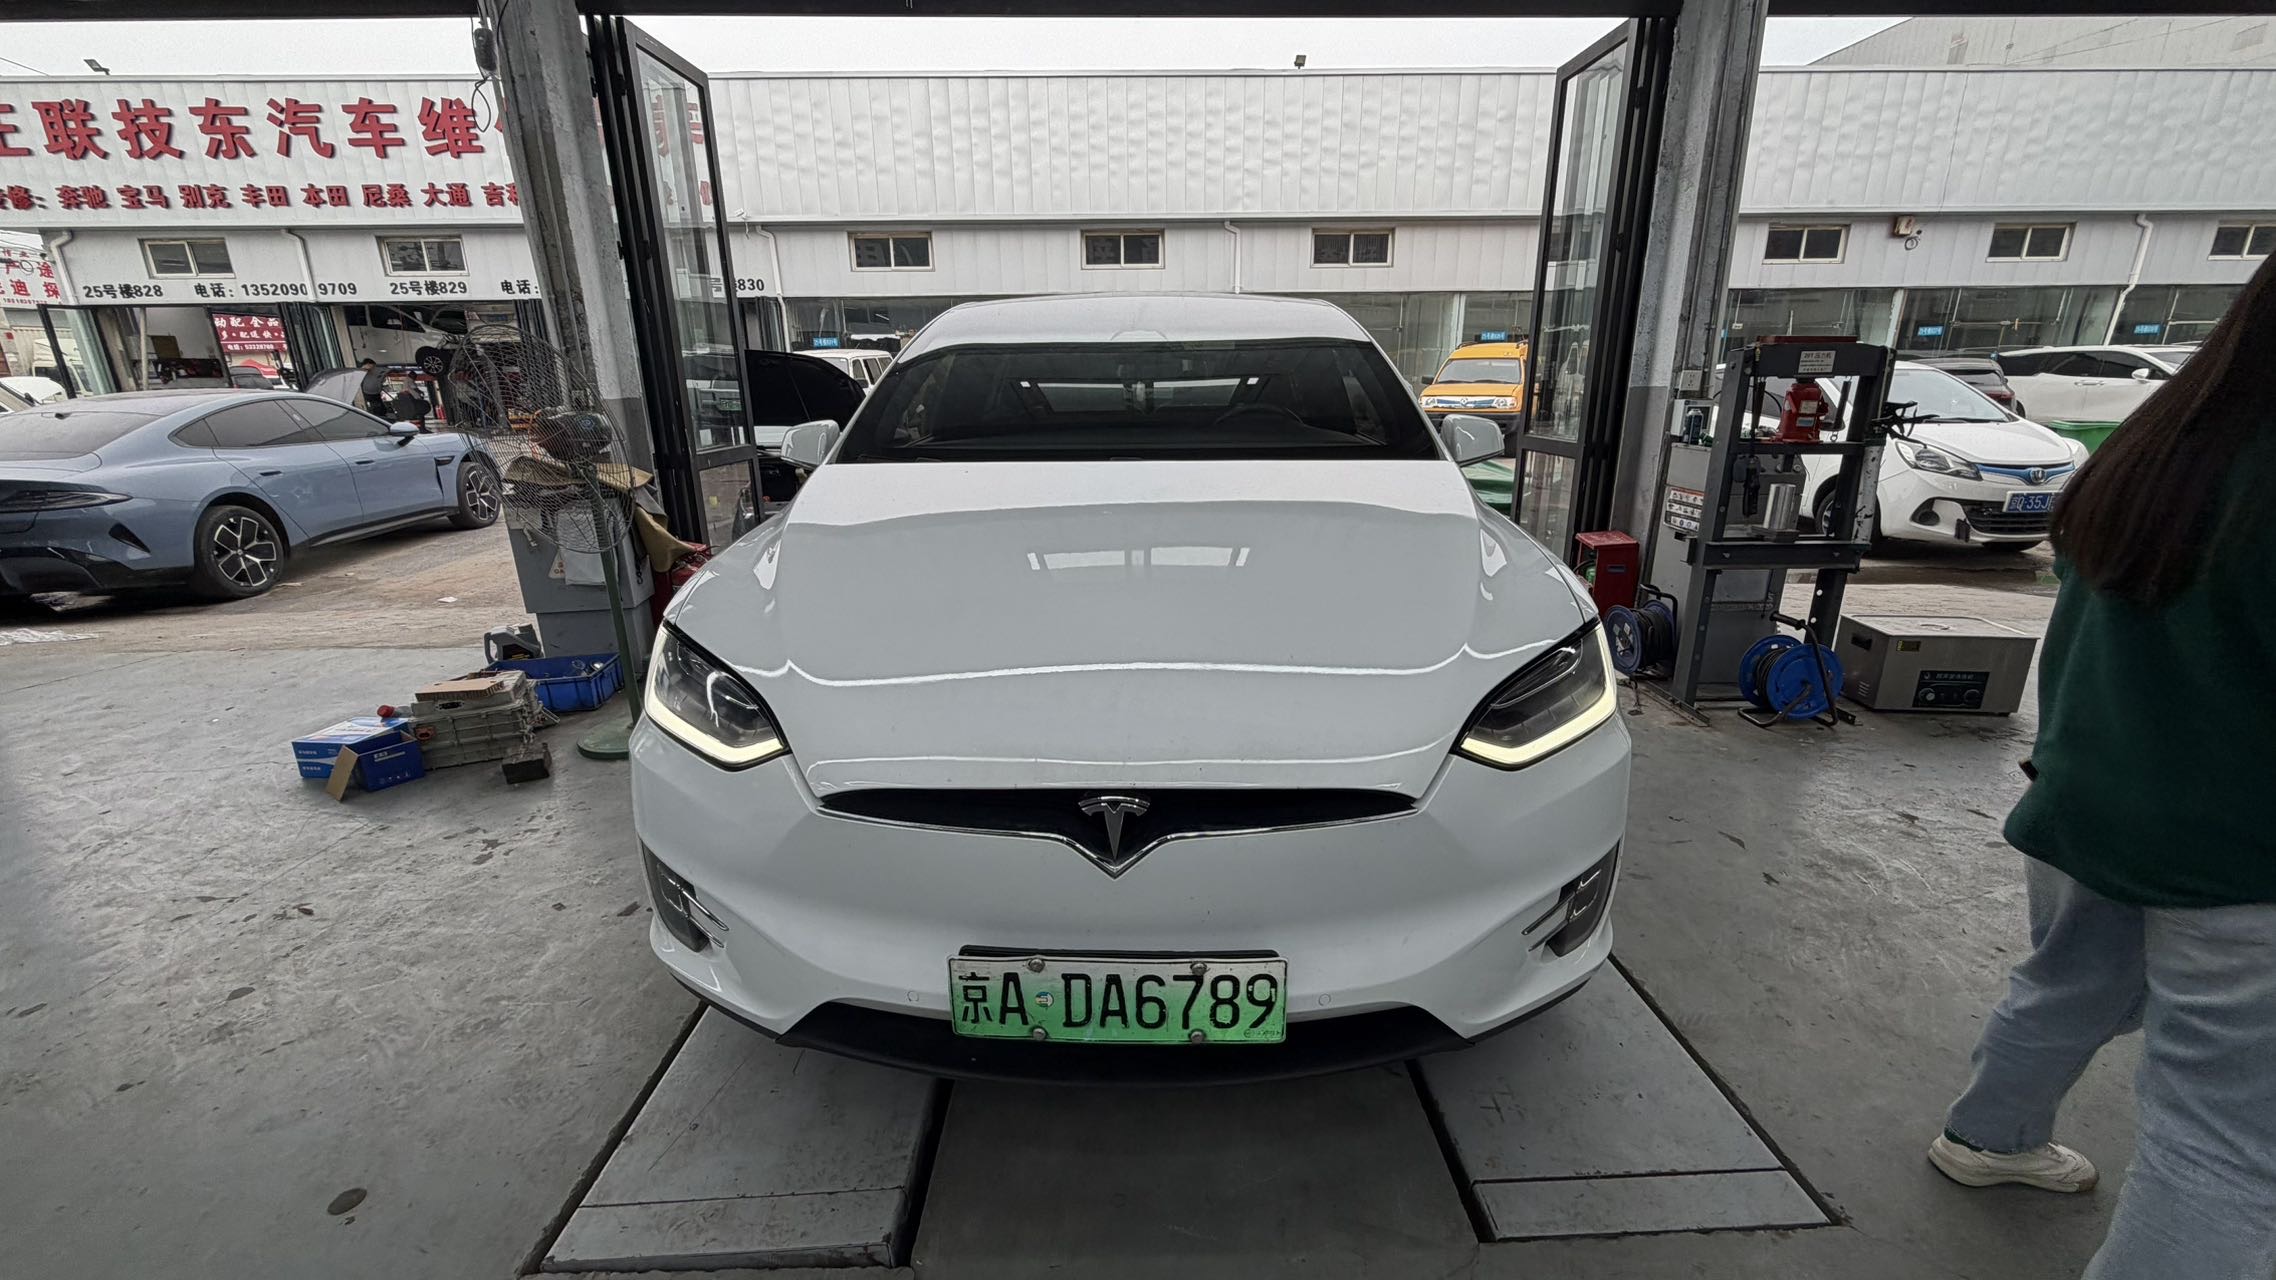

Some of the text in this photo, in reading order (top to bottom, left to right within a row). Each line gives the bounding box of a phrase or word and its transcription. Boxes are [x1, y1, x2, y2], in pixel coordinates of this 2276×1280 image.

[55, 184, 110, 209] 奔驰
[116, 185, 170, 209] 宝马
[178, 184, 232, 209] 别克
[241, 184, 290, 208] 丰田
[301, 183, 350, 208] 本田
[361, 183, 413, 208] 尼桑
[420, 182, 473, 207] 大通
[83, 284, 163, 298] 25号楼828
[390, 281, 467, 295] 25号楼829
